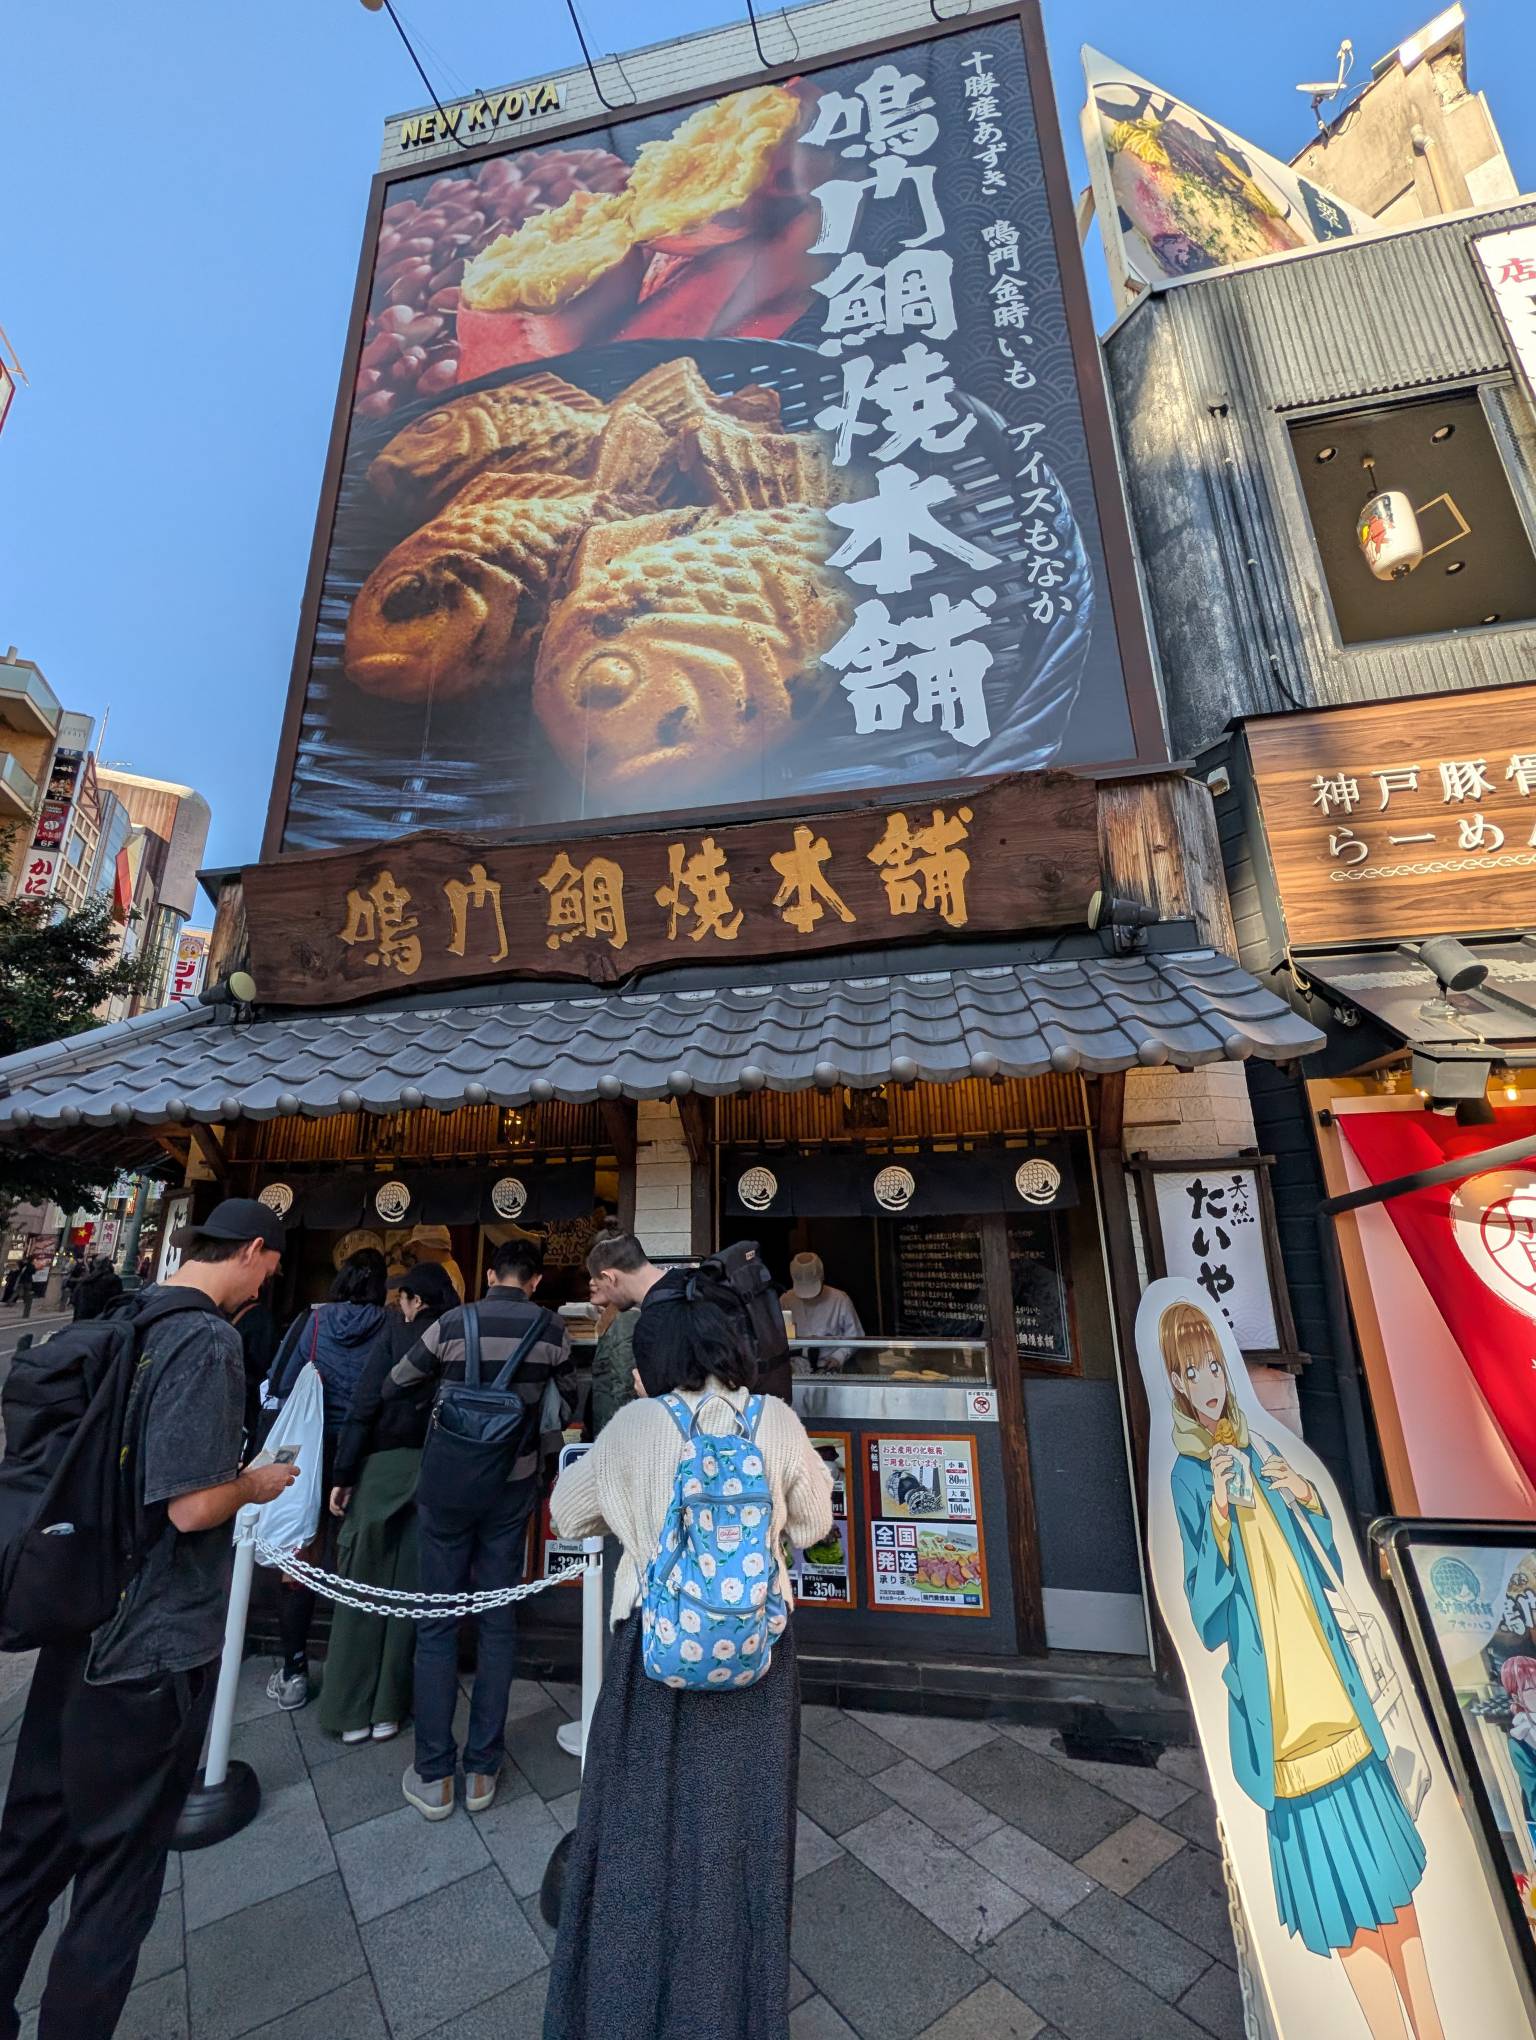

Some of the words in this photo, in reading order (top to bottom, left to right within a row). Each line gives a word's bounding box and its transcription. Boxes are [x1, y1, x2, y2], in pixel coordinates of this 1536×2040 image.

[400, 106, 462, 150] NEW
[468, 83, 560, 132] KYOYA
[961, 51, 1007, 195] 十勝産あずき
[980, 219, 1037, 389] 鳴門金時いも
[800, 65, 1002, 747] 鳴門鯛焼本舗
[1008, 422, 1072, 624] アイスもなか
[1328, 813, 1536, 865] らーめ
[25, 858, 52, 896] かに
[339, 805, 975, 977] 鳴門鯛焼本舗
[170, 961, 196, 1001] ジャ
[1227, 1175, 1255, 1226] 天然
[876, 1526, 917, 1548] 全国
[877, 1551, 918, 1573] 発送
